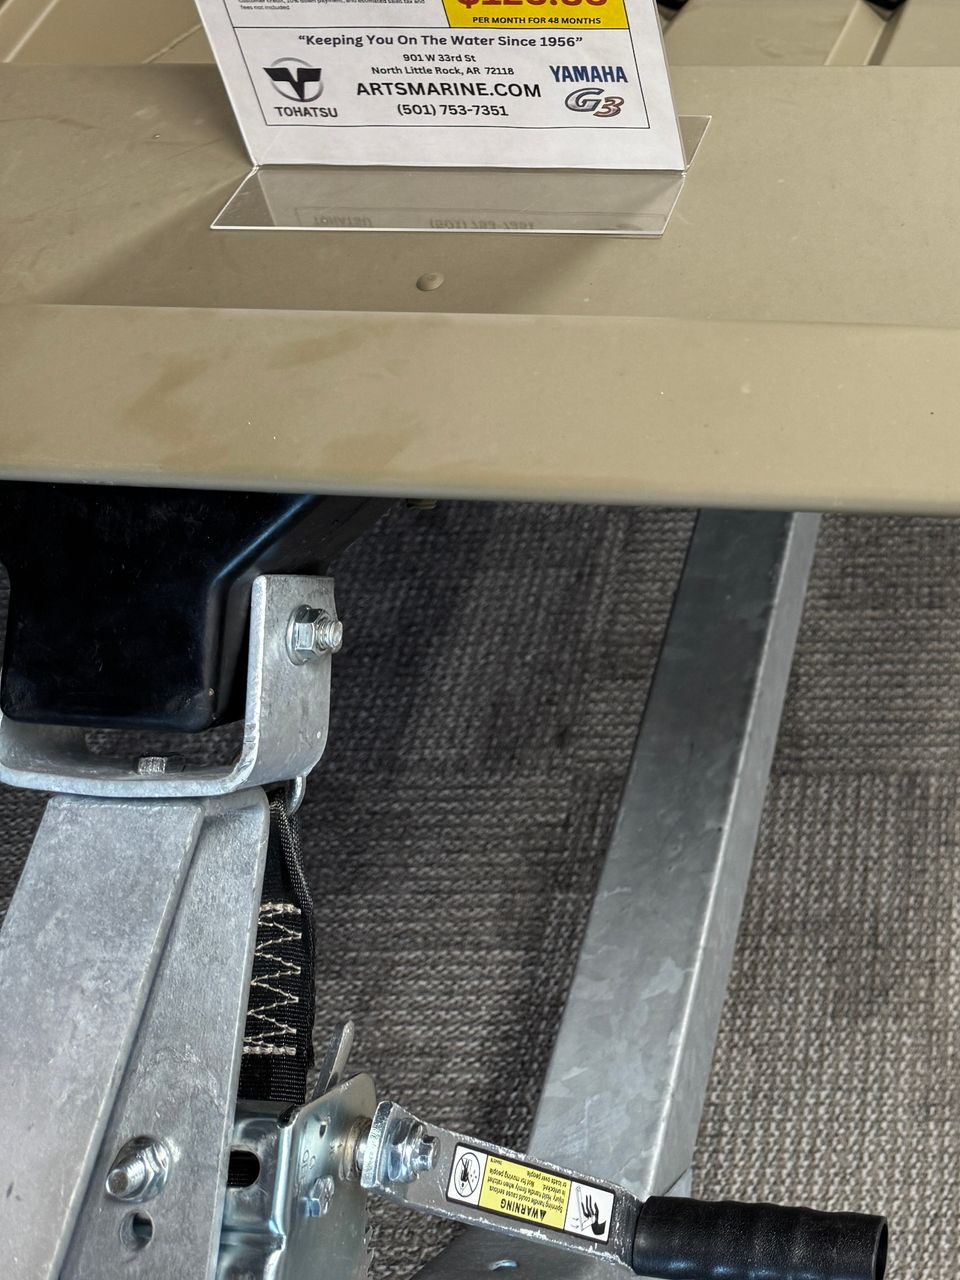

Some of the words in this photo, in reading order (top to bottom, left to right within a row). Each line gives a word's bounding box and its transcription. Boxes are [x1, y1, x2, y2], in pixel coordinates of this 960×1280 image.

[298, 34, 363, 47] “Keeping
[366, 35, 394, 45] You
[397, 35, 419, 45] On
[421, 35, 447, 45] The
[450, 36, 494, 46] Water
[498, 36, 536, 46] Since
[540, 36, 583, 47] 1956”
[403, 54, 423, 62] 901
[424, 54, 436, 62] W
[438, 54, 462, 62] 33rd
[435, 67, 464, 76] Rock,
[549, 66, 628, 83] YAMAHA
[356, 82, 542, 97] ARTSMARINE.COM
[565, 87, 625, 118] G3
[274, 106, 338, 118] TOHATSU
[397, 104, 436, 116] (501)
[439, 104, 509, 116] 753-7351
[505, 1171, 519, 1181] moving
[490, 1186, 505, 1194] serious
[515, 1184, 527, 1193] firmly
[528, 1189, 541, 1197] handle
[501, 1199, 538, 1219] WARNING
[545, 1201, 562, 1213] Spinning
